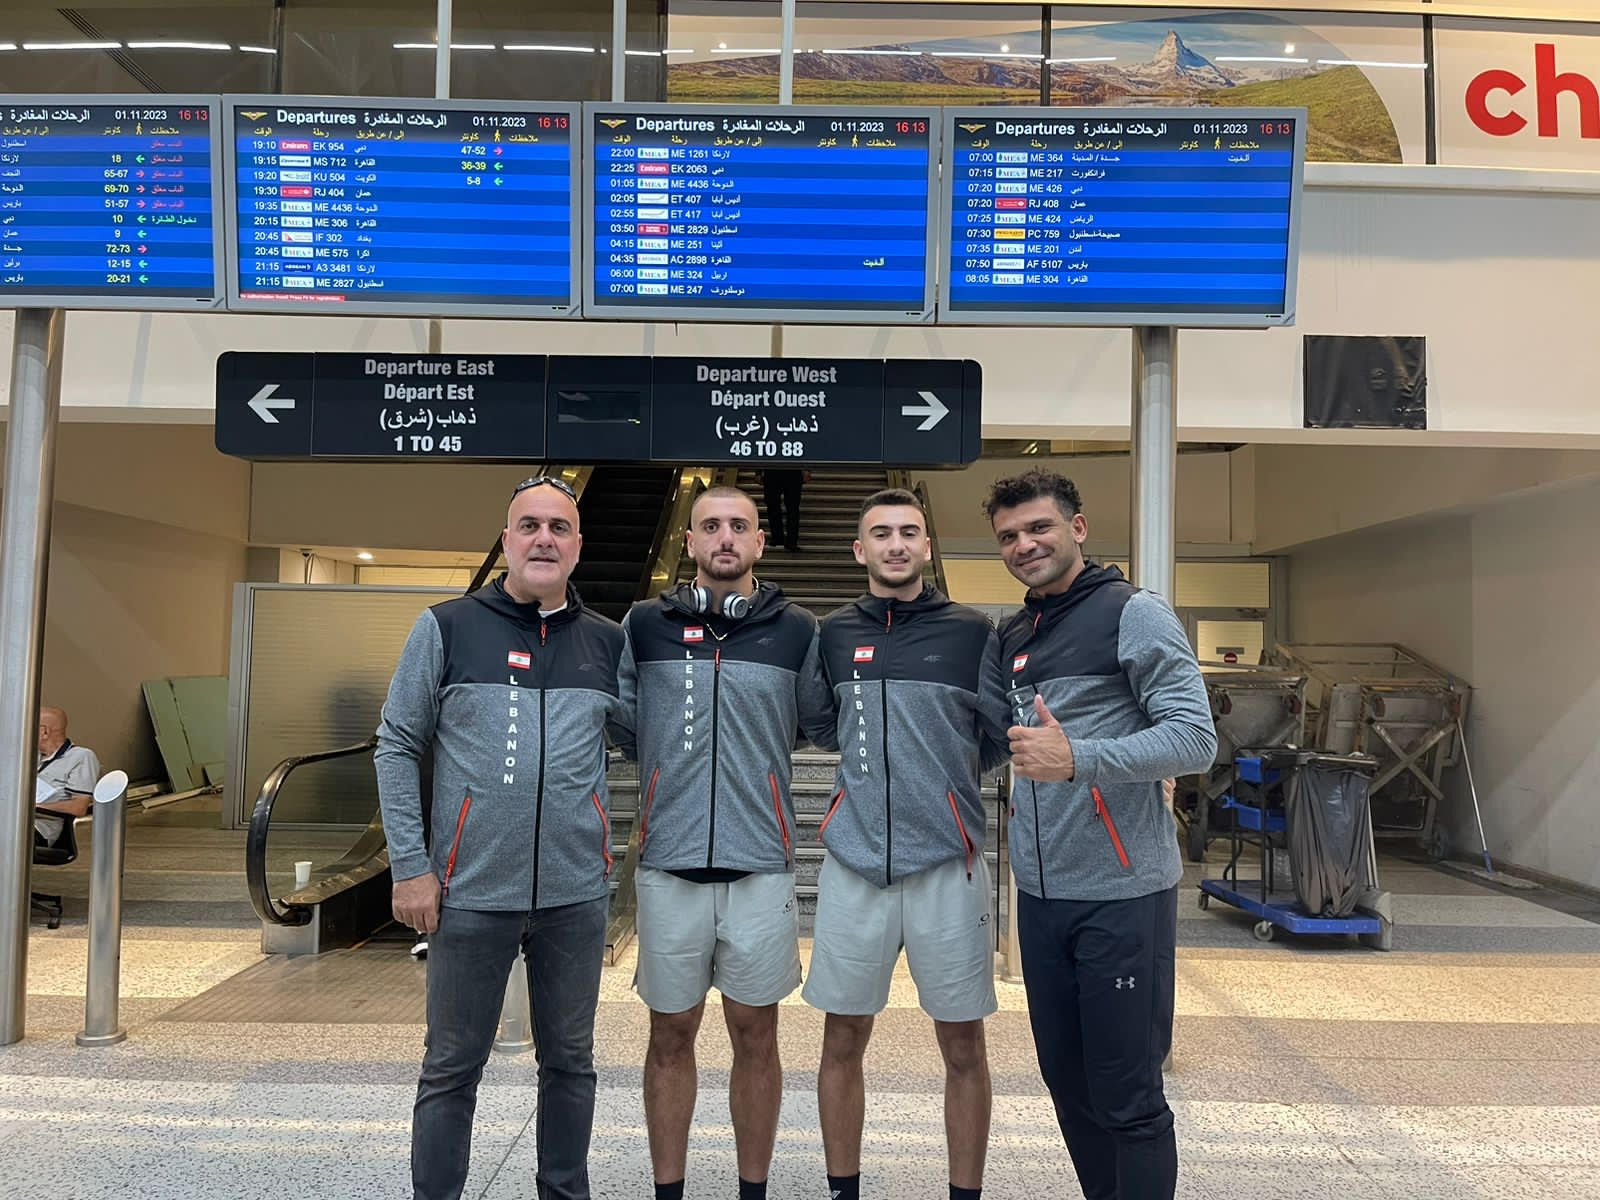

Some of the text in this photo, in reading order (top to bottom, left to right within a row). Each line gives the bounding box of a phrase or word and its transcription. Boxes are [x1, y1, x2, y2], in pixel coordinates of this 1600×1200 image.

[1465, 43, 1600, 138] ch
[11, 110, 90, 123] الرحلات المغادرة
[114, 111, 167, 120] 01.11.2023
[178, 110, 207, 120] 16 13
[277, 110, 447, 128] Departures الرحلات المغادرة
[473, 117, 526, 126] 01.11.2023
[538, 118, 567, 128] 16 13
[636, 118, 805, 134] Departures الرحلات المغادرة
[831, 122, 884, 132] 01.11.2023
[896, 122, 925, 133] 16 13
[996, 122, 1167, 136] Departures الرحلات المغادرة
[1194, 124, 1247, 134] 01.11.2023
[1260, 124, 1290, 134] 16 13
[313, 142, 326, 150] EK
[328, 142, 344, 150] 954
[461, 146, 486, 155] 47-52
[611, 149, 634, 157] 22:00
[672, 150, 685, 158] ME
[969, 153, 993, 161] 07:00
[1048, 154, 1063, 162] 364
[112, 154, 122, 163] 18
[314, 158, 328, 166] MS
[331, 158, 346, 166] 712
[462, 162, 486, 170] 36-39
[611, 164, 634, 172] 22:25
[104, 170, 128, 178] 65-67
[254, 172, 277, 180] 19:20
[314, 173, 327, 181] KU
[969, 169, 992, 177] 07:15
[1030, 169, 1044, 177] ME
[1048, 169, 1063, 177] 217
[467, 177, 480, 185] 5-8
[672, 180, 685, 188] ME
[104, 184, 129, 193] 69-70
[254, 187, 277, 195] 19:30
[314, 188, 325, 196] RJ
[968, 184, 992, 192] 07:20
[1030, 184, 1043, 192] ME
[611, 194, 634, 202] 02:05
[685, 196, 701, 204] 407
[105, 200, 129, 208] 51-57
[254, 202, 277, 210] 19:35
[315, 203, 328, 211] ME
[1028, 200, 1040, 208] RJ
[1043, 200, 1059, 208] 408
[671, 210, 683, 218] ET
[685, 211, 701, 219] 417
[968, 214, 1061, 223] 07:25 ME 424
[254, 217, 278, 225] 20:15
[315, 218, 329, 226] ME
[611, 224, 634, 233] 03:50
[688, 226, 708, 234] 2829
[114, 230, 120, 238] 9
[255, 232, 278, 240] 20:45
[326, 234, 342, 242] 302
[967, 230, 991, 238] 07:30
[1028, 230, 1041, 238] PC
[1044, 230, 1059, 238] 759
[106, 245, 131, 253] 72-73
[688, 241, 702, 249] 251
[966, 245, 1059, 253] 07:35 ME 201
[256, 247, 279, 255] 20:45
[316, 249, 330, 257] ME
[611, 254, 634, 262] 04:35
[670, 256, 684, 264] AC
[107, 260, 131, 268] 12-15
[331, 264, 350, 272] 3481
[966, 260, 990, 268] 07:50
[1027, 260, 1039, 268] AF
[1042, 260, 1062, 268] 5107
[107, 275, 130, 283] 20-21
[611, 270, 703, 279] 06:00 ME 324
[316, 279, 330, 287] ME
[611, 285, 634, 293] 07:00
[688, 286, 703, 294] 247
[366, 360, 494, 378] Departure East
[697, 366, 837, 385] Departure West
[384, 384, 474, 402] Départ Est
[712, 390, 826, 409] Départ Ouest
[380, 409, 476, 431] ذهاب (شرق)
[715, 416, 818, 439] ذهاب (غرب)
[394, 436, 462, 451] 1 TO 45
[730, 442, 803, 457] 46 TO 88
[684, 650, 694, 751] LEBANON
[854, 670, 869, 772] LEBANON
[504, 675, 519, 784] LEBANON
